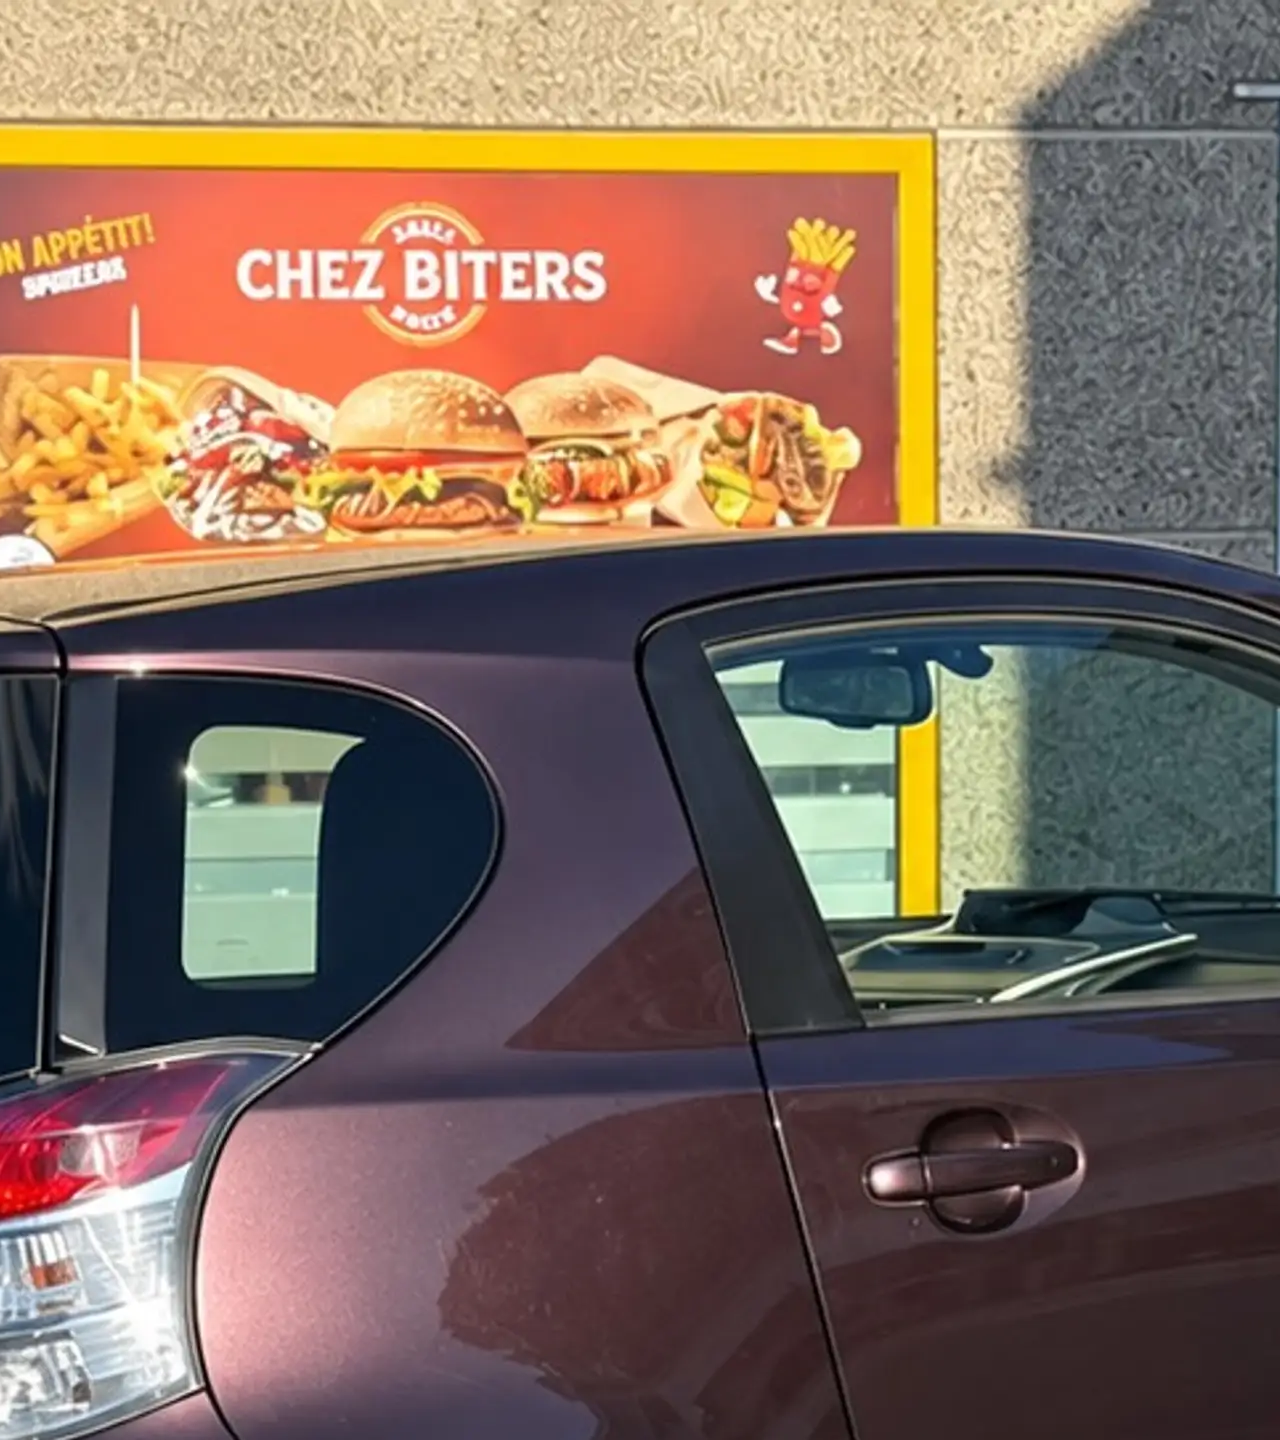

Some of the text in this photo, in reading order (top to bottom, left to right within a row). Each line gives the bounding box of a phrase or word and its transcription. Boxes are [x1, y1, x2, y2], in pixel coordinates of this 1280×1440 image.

[33, 213, 156, 268] APPÉTIT!
[236, 248, 608, 302] CHEZ BITERS
